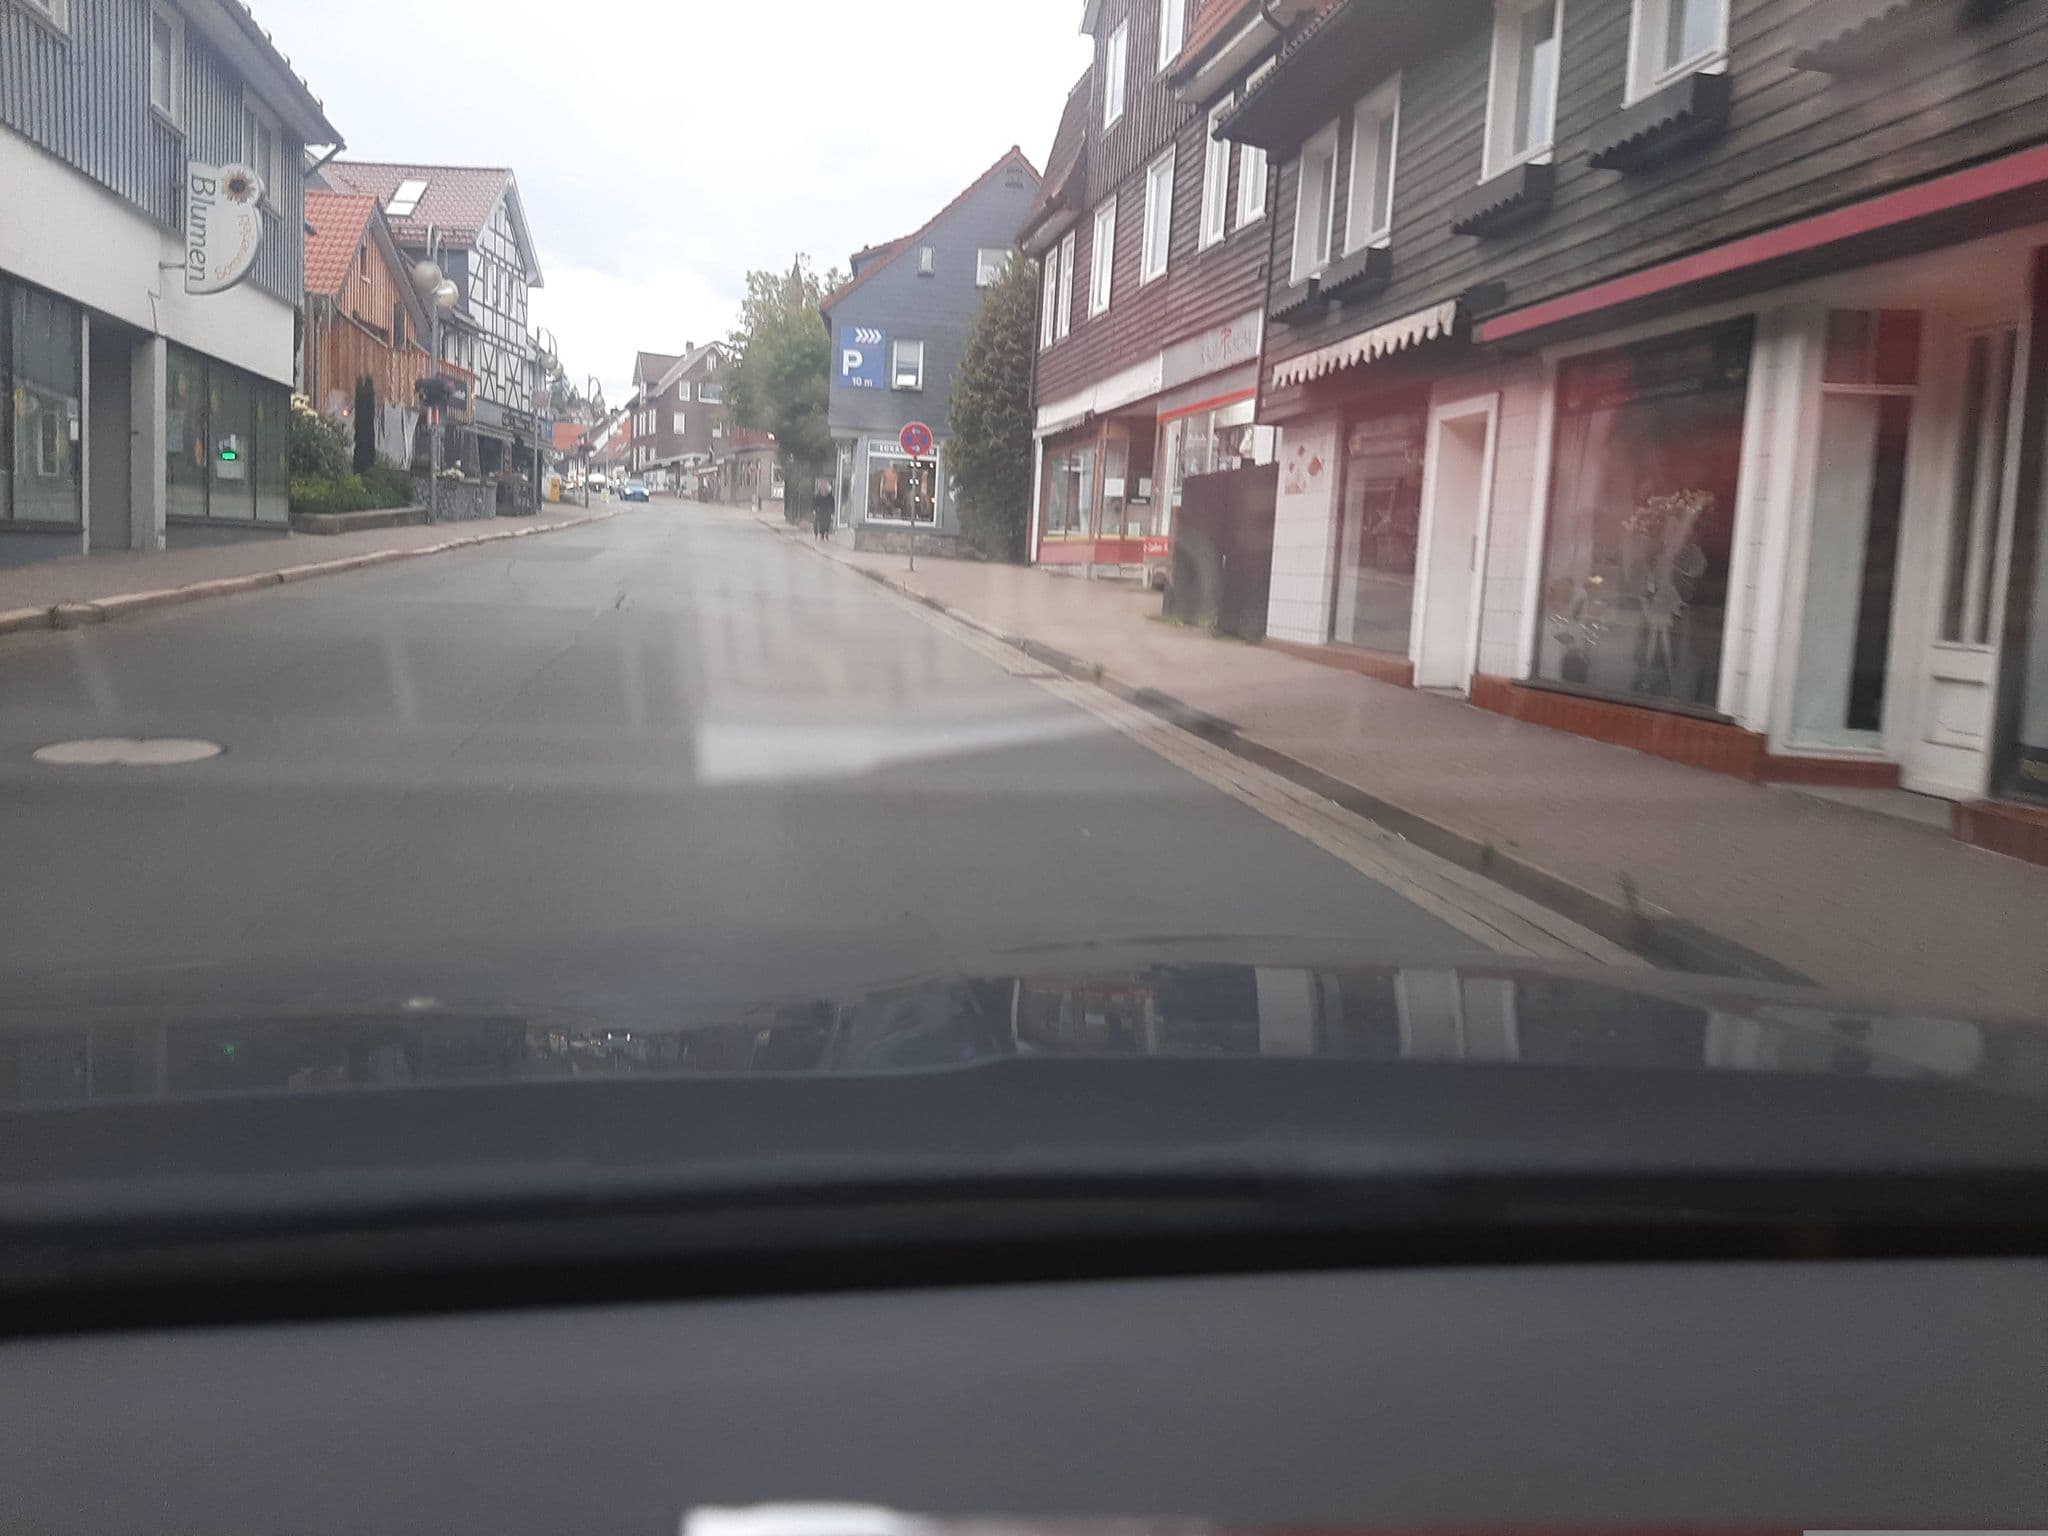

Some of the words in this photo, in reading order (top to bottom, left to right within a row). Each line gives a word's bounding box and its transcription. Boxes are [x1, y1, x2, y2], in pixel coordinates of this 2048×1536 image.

[189, 174, 216, 281] Blumen
[842, 348, 863, 376] P
[852, 376, 863, 387] 10
[864, 378, 873, 387] m
